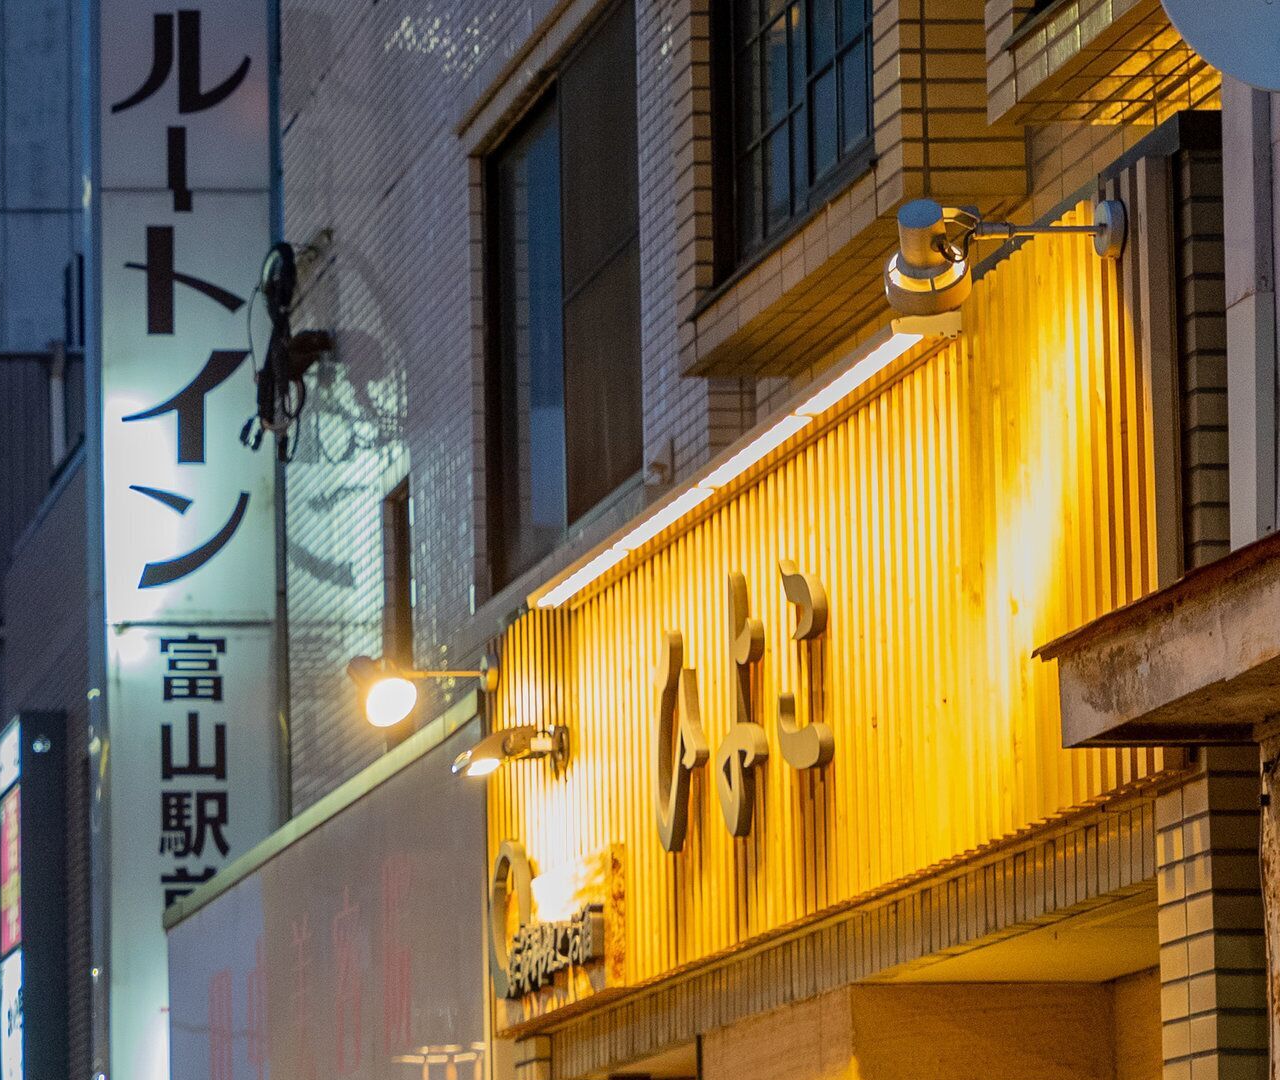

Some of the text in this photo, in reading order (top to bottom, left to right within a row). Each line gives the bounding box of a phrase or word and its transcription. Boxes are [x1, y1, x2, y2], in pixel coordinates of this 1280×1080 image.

[112, 10, 251, 589] ルートイン
[654, 559, 835, 852] ひよこ
